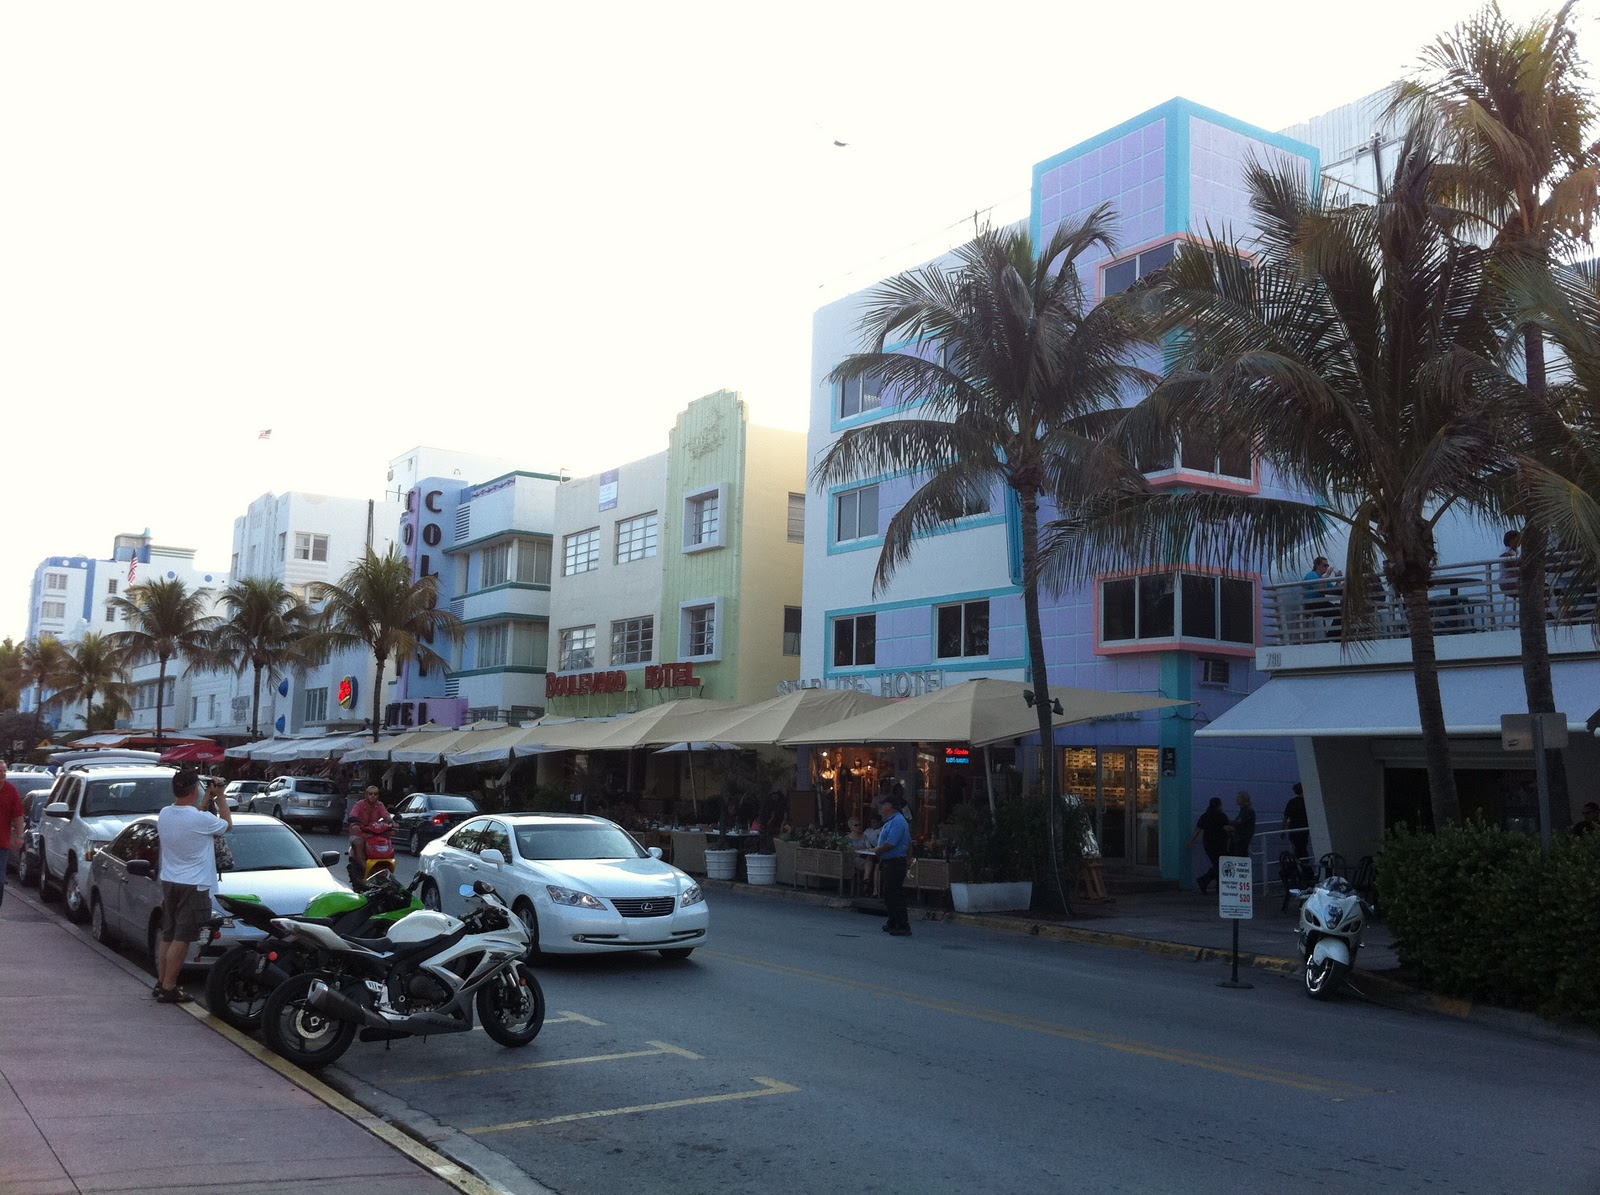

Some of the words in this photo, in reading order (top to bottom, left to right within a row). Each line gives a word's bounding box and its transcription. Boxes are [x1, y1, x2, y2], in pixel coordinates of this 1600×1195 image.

[546, 670, 627, 698] BOULEVARD
[645, 662, 701, 689] HOTEL
[1239, 881, 1250, 891] $15
[1239, 893, 1251, 903] $20
